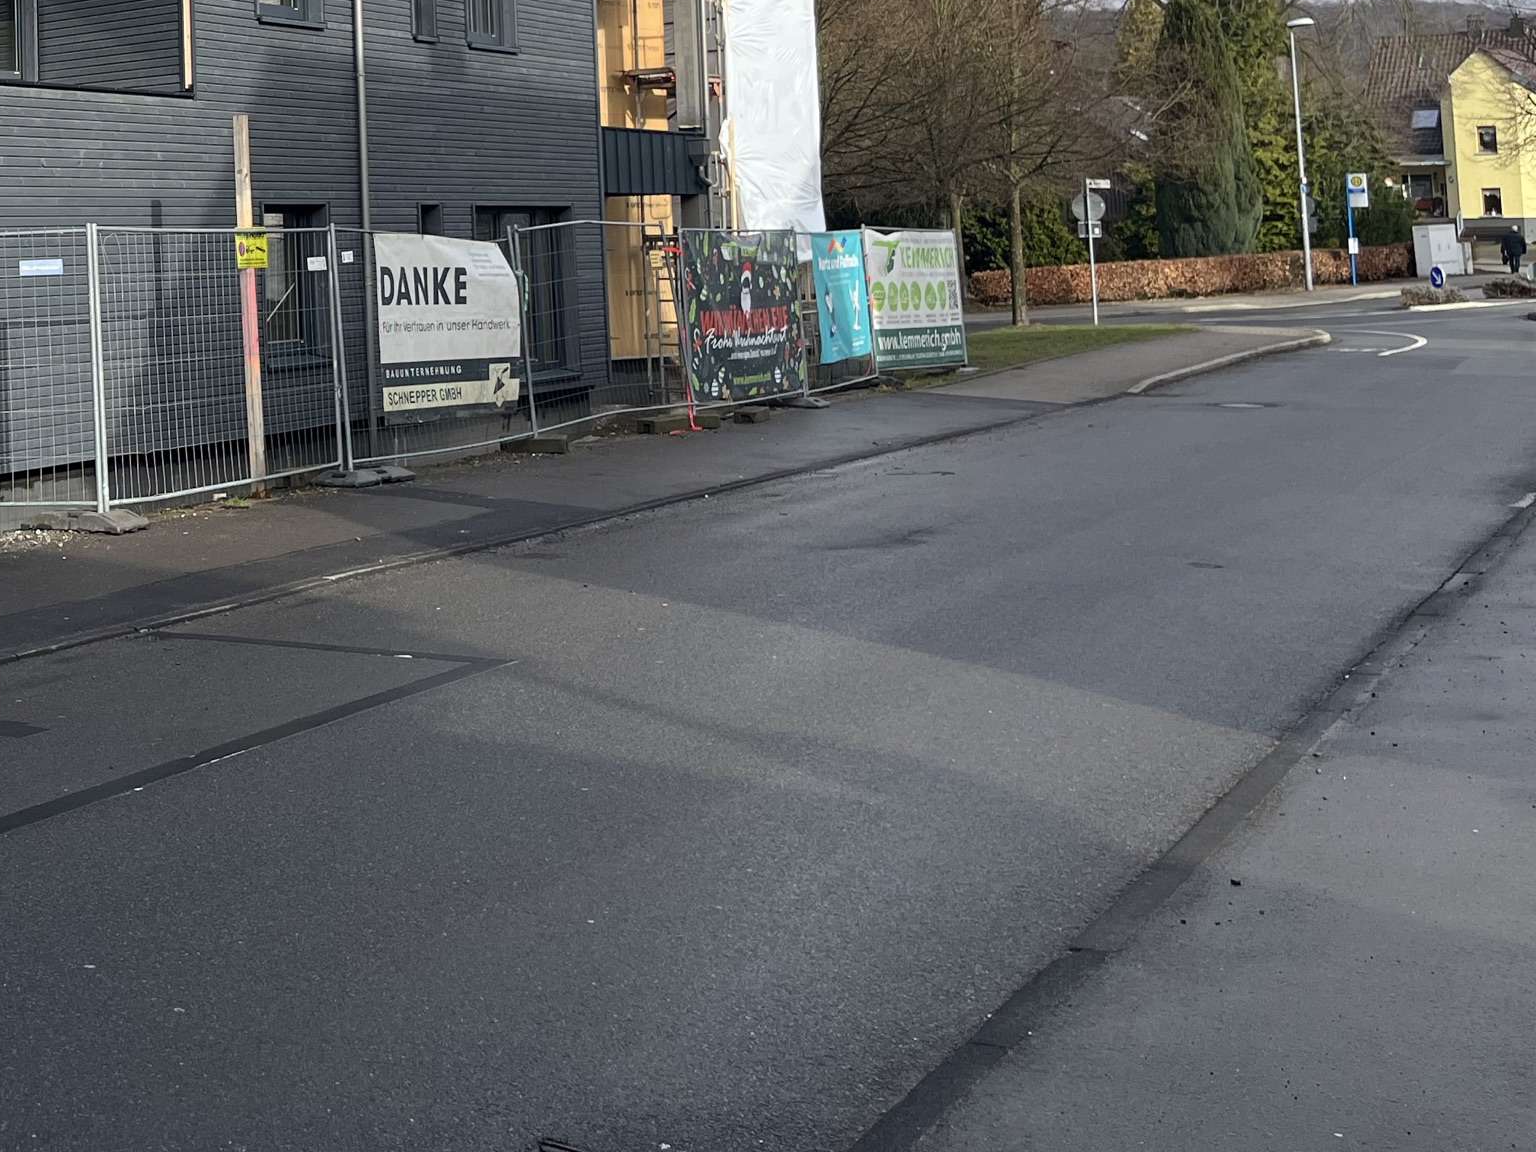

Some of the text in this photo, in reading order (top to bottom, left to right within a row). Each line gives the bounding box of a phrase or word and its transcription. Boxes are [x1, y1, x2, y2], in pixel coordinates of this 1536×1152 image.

[899, 246, 954, 269] KEMMERICH
[380, 266, 468, 306] DANKE
[382, 320, 393, 333] Für
[403, 320, 435, 332] Vertrauen
[446, 320, 470, 332] unser
[705, 327, 733, 354] Frohe
[877, 328, 962, 351] www.kemmerich.gmbh
[385, 365, 462, 379] BAUUNTERNEHMUNG
[388, 389, 438, 406] SCHNEPPER
